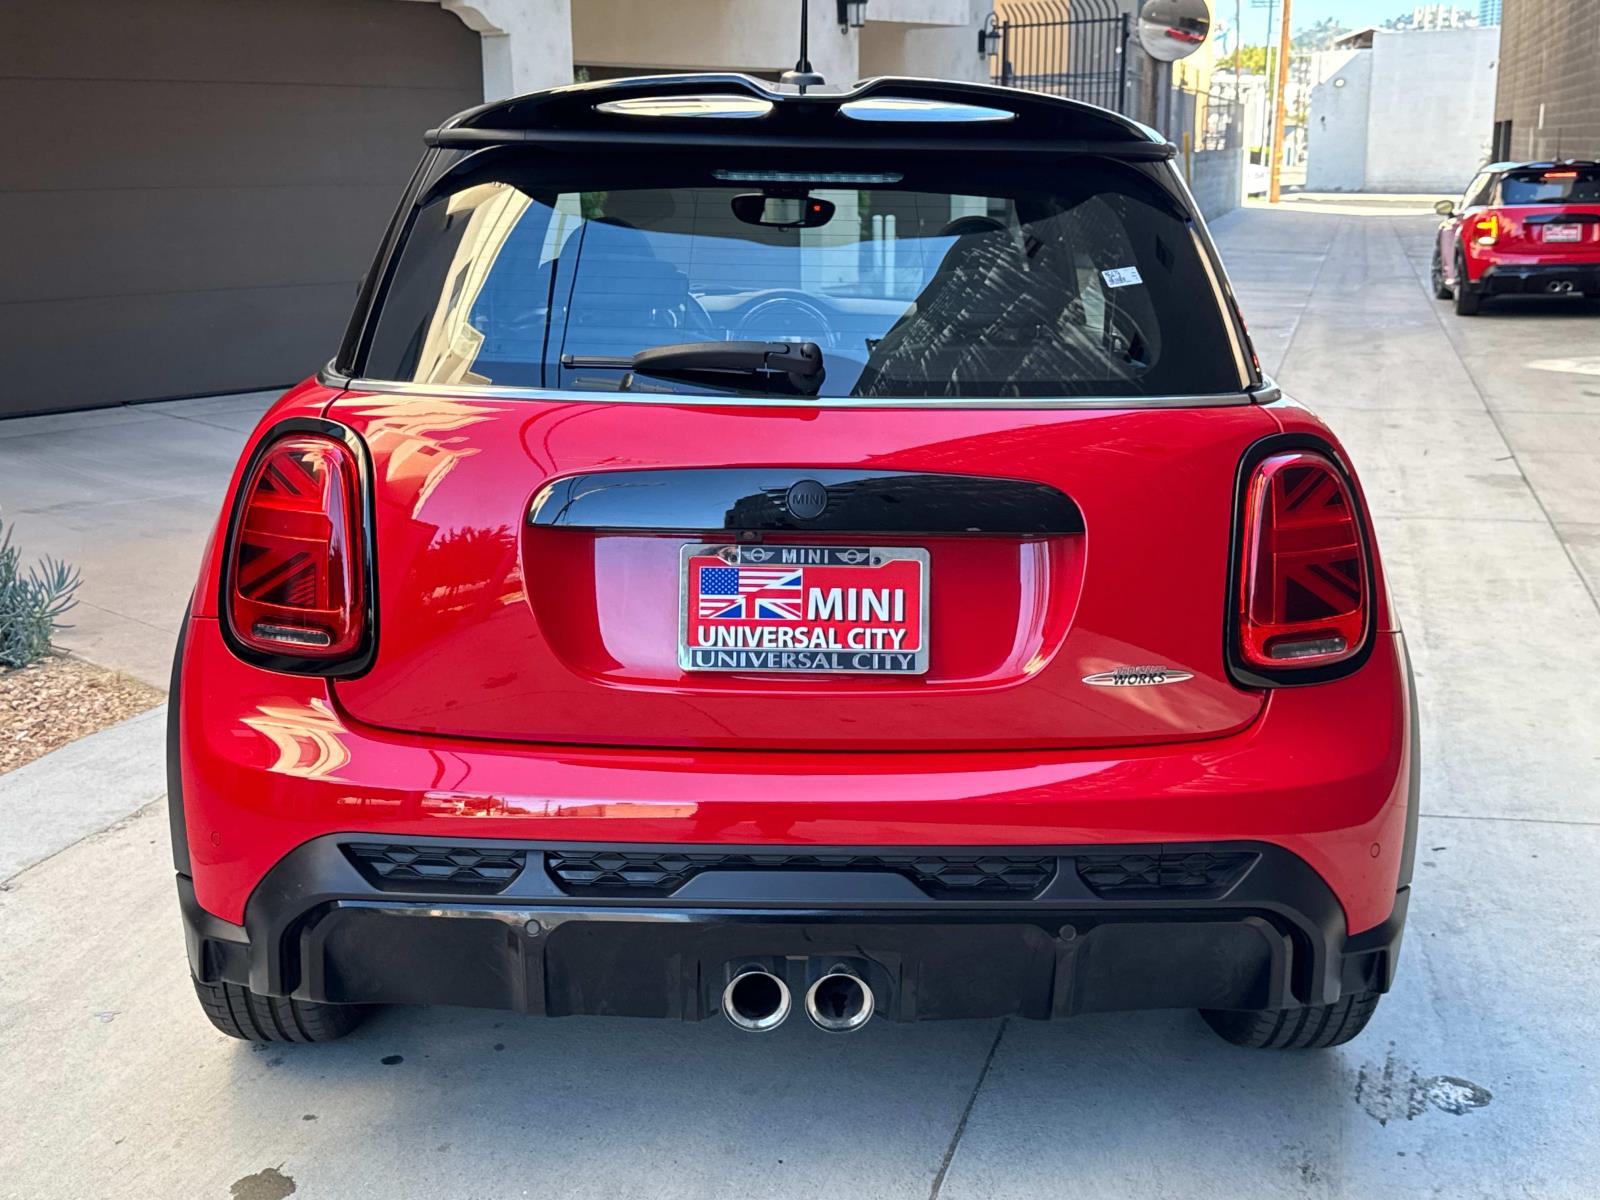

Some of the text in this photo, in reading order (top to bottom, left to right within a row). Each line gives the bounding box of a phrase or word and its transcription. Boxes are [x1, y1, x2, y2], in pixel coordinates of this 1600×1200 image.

[792, 493, 823, 505] MINI
[782, 549, 829, 564] MINI
[807, 587, 904, 622] MINI
[697, 625, 906, 650] UNIVERSAL CITY
[696, 651, 913, 670] UNIVERSAL CITY
[1113, 672, 1167, 685] WORKS
